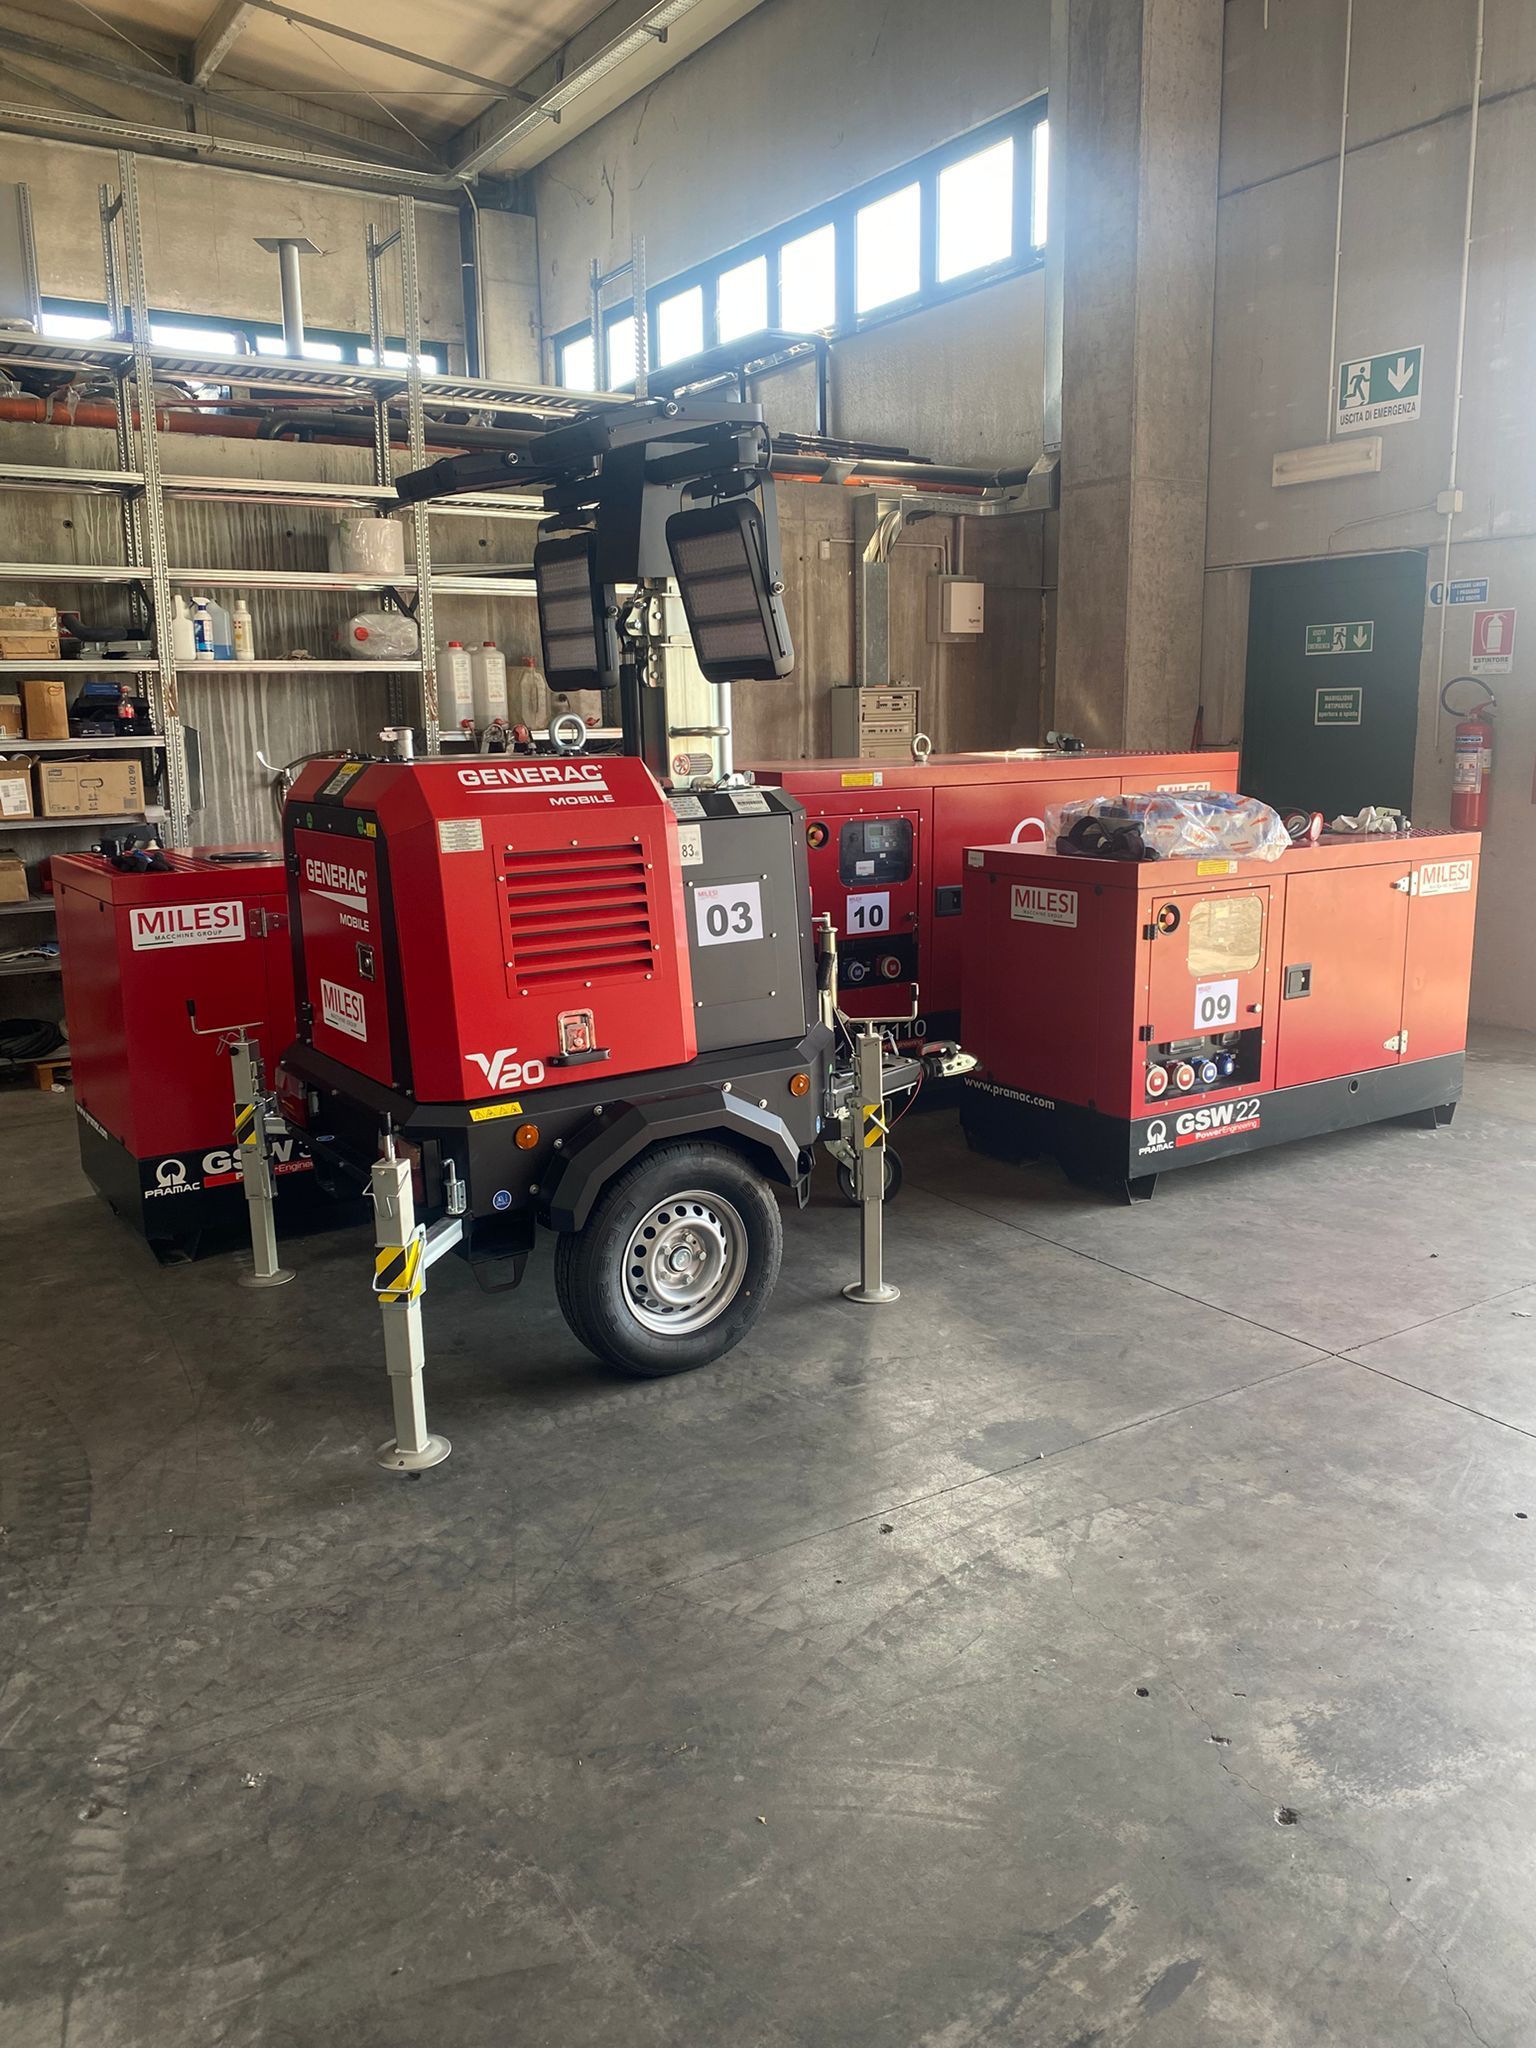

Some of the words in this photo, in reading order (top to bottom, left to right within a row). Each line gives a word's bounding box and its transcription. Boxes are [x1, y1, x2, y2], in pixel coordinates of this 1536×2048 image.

[1340, 412, 1363, 425] USCITA
[1365, 410, 1372, 420] DI
[1373, 402, 1416, 419] EMERGENZA
[458, 765, 602, 786] GENERAC
[549, 794, 616, 806] MOBILE
[681, 844, 694, 858] 83
[305, 858, 366, 895] GENERAC
[1423, 863, 1470, 885] MILESI
[1015, 888, 1073, 914] MILESI
[137, 905, 239, 935] MILESI
[339, 913, 370, 932] MOBILE
[706, 901, 753, 937] 03
[853, 904, 884, 928] 10
[154, 931, 194, 941] MACCHINE
[323, 983, 363, 1023] MILESI
[1201, 994, 1231, 1022] 09
[964, 1077, 1055, 1110] www.pramac.com
[1138, 1141, 1174, 1156] PRAMAC
[144, 1181, 200, 1199] PRAMAC
